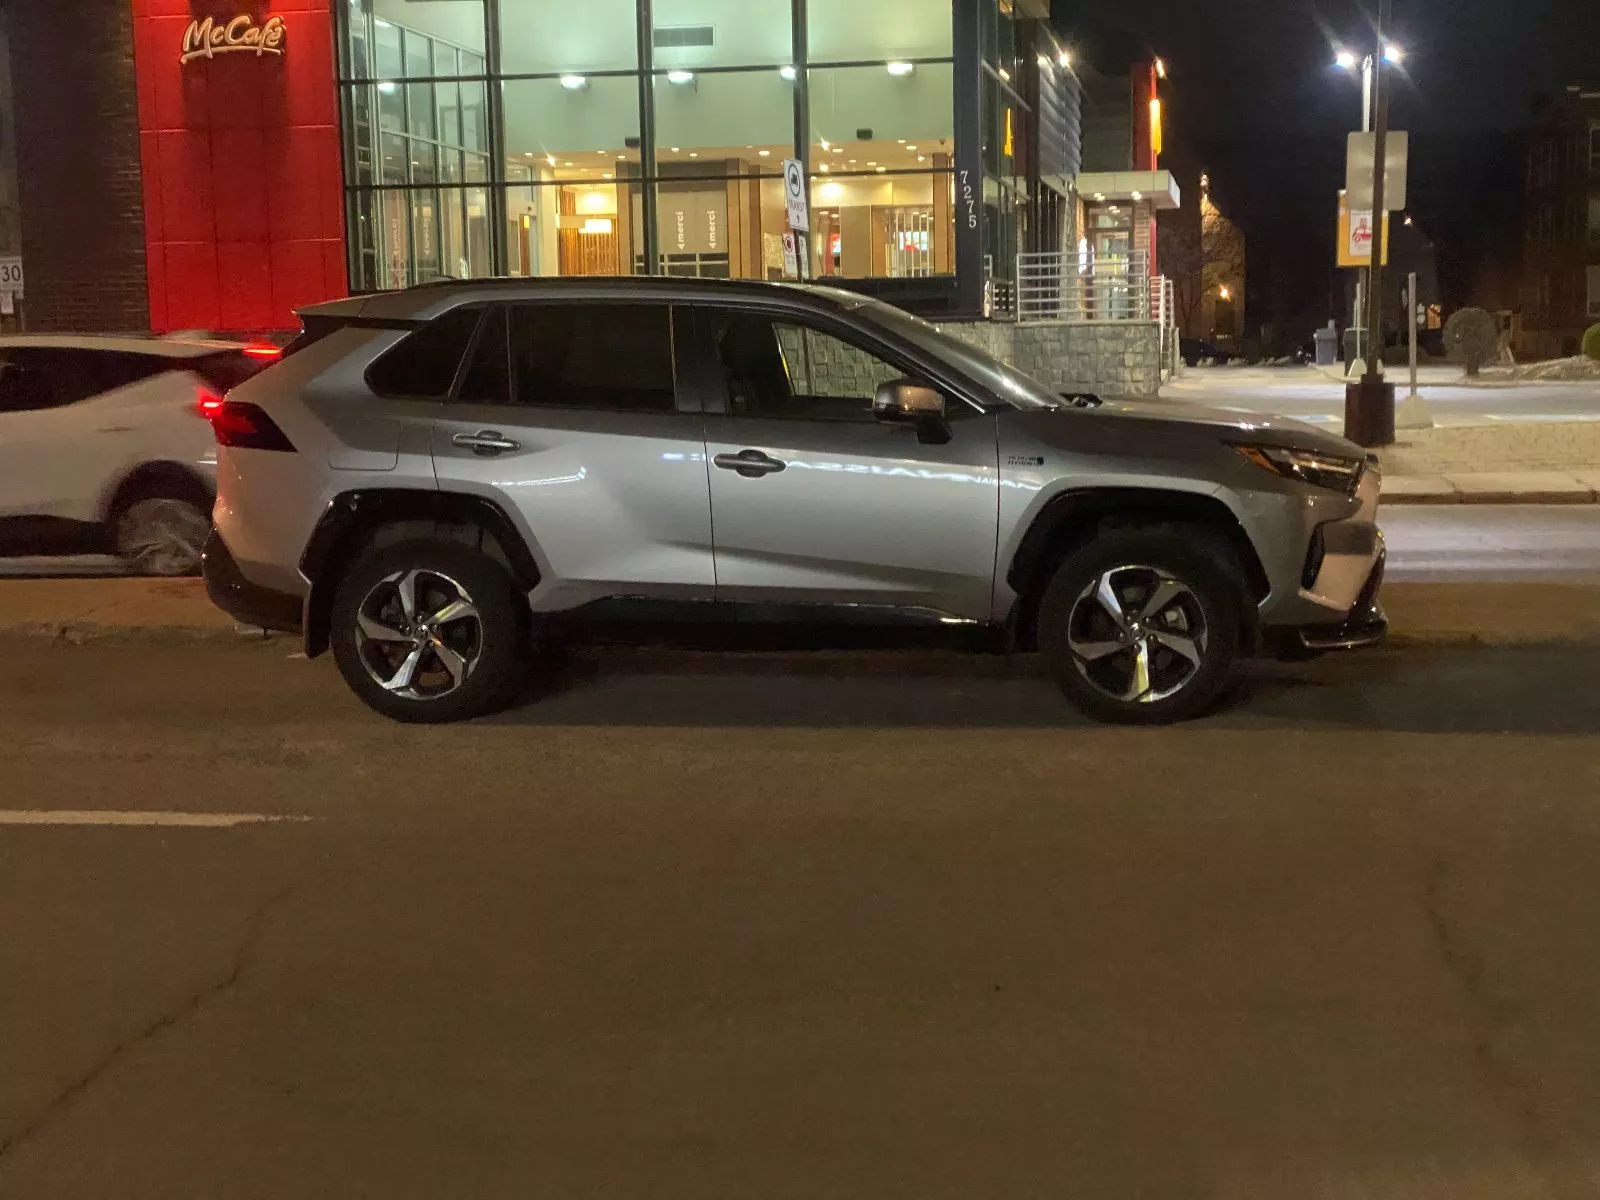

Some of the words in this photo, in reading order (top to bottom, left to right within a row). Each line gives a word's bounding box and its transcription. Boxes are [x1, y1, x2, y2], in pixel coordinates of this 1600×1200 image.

[182, 14, 284, 59] McCafé
[960, 170, 977, 229] 7275
[675, 211, 685, 243] merci
[707, 210, 716, 242] merci
[2, 265, 21, 282] 30
